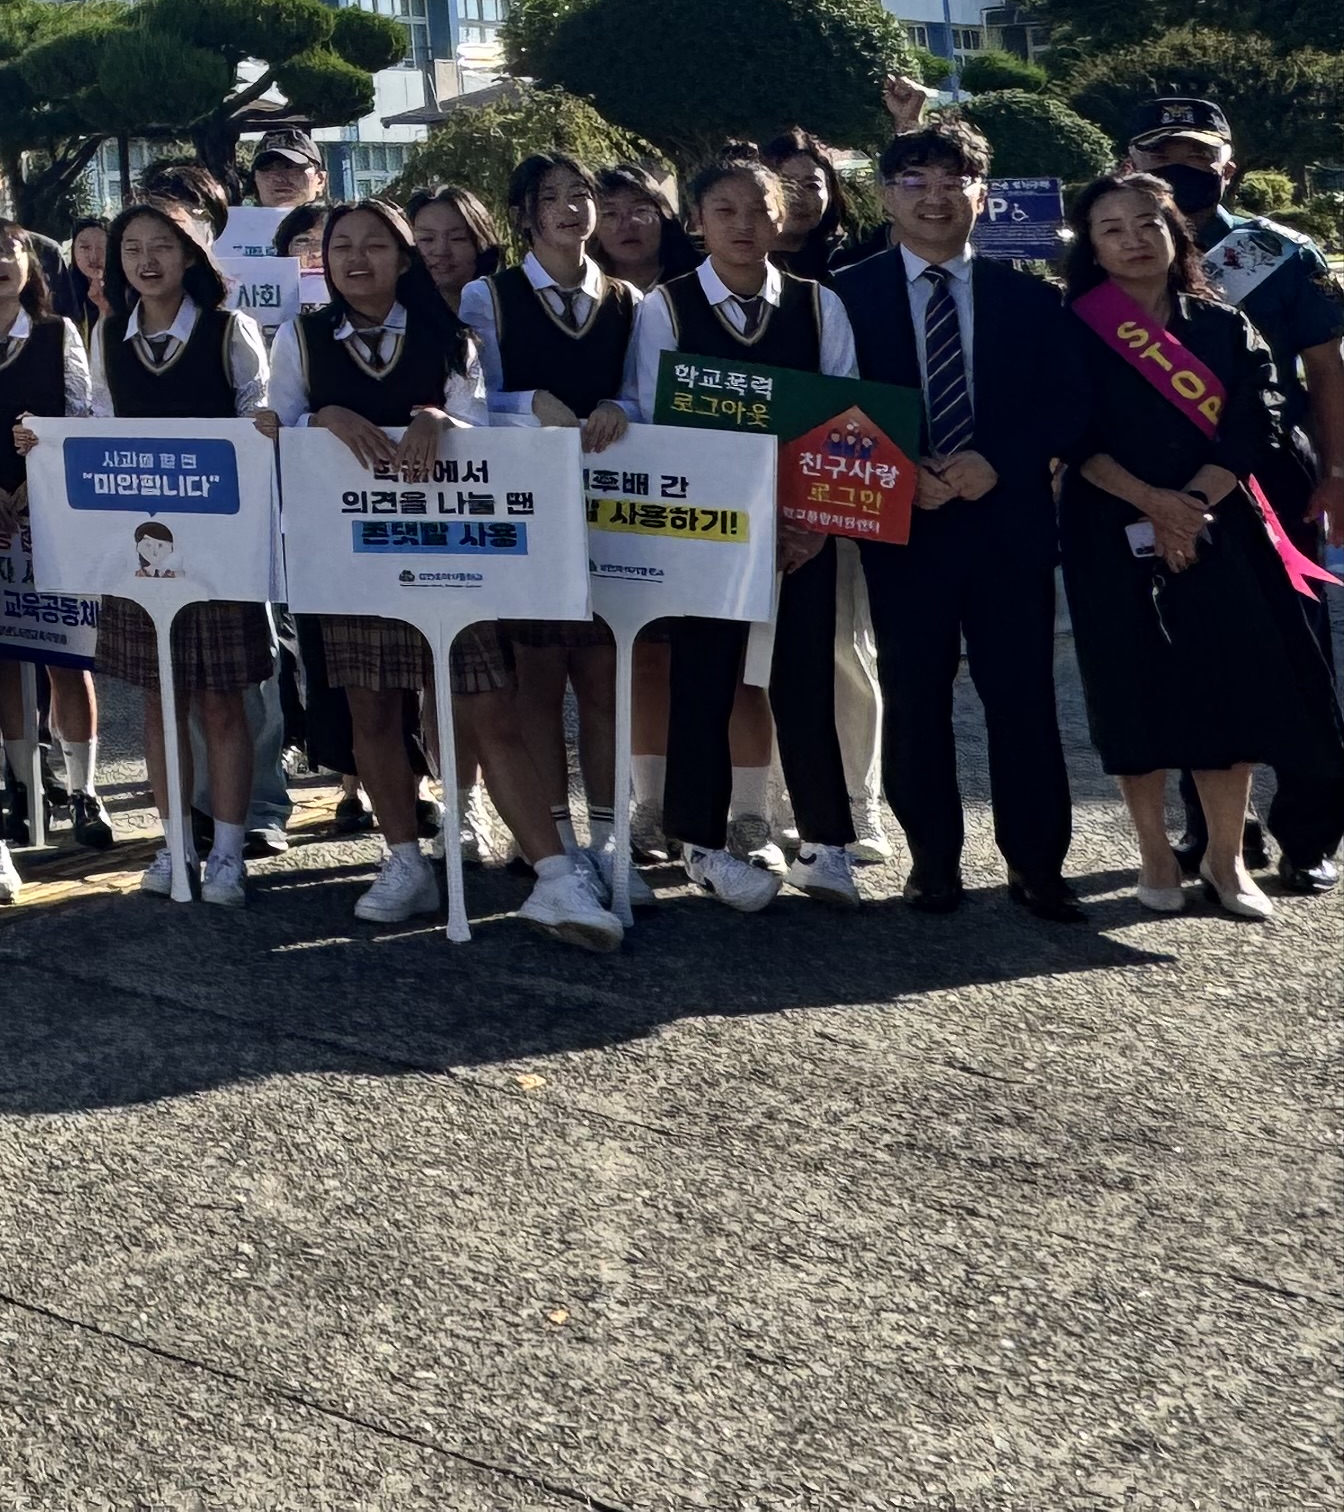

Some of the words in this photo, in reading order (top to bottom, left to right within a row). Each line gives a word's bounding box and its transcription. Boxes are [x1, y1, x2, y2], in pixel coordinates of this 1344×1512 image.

[988, 198, 1008, 222] P
[675, 364, 773, 400] 학교폭력
[1117, 321, 1223, 425] STOP
[671, 392, 772, 428] 로그아웃
[583, 469, 649, 496] 후배
[661, 475, 689, 498] 간
[799, 451, 900, 489] 친구사랑
[342, 491, 427, 514] 의견을
[807, 483, 883, 515] 로그인
[361, 521, 448, 546] 존댓말
[459, 521, 517, 548] 사용
[610, 501, 738, 535] 사용하기!
[4, 590, 100, 628] 교육공동체
